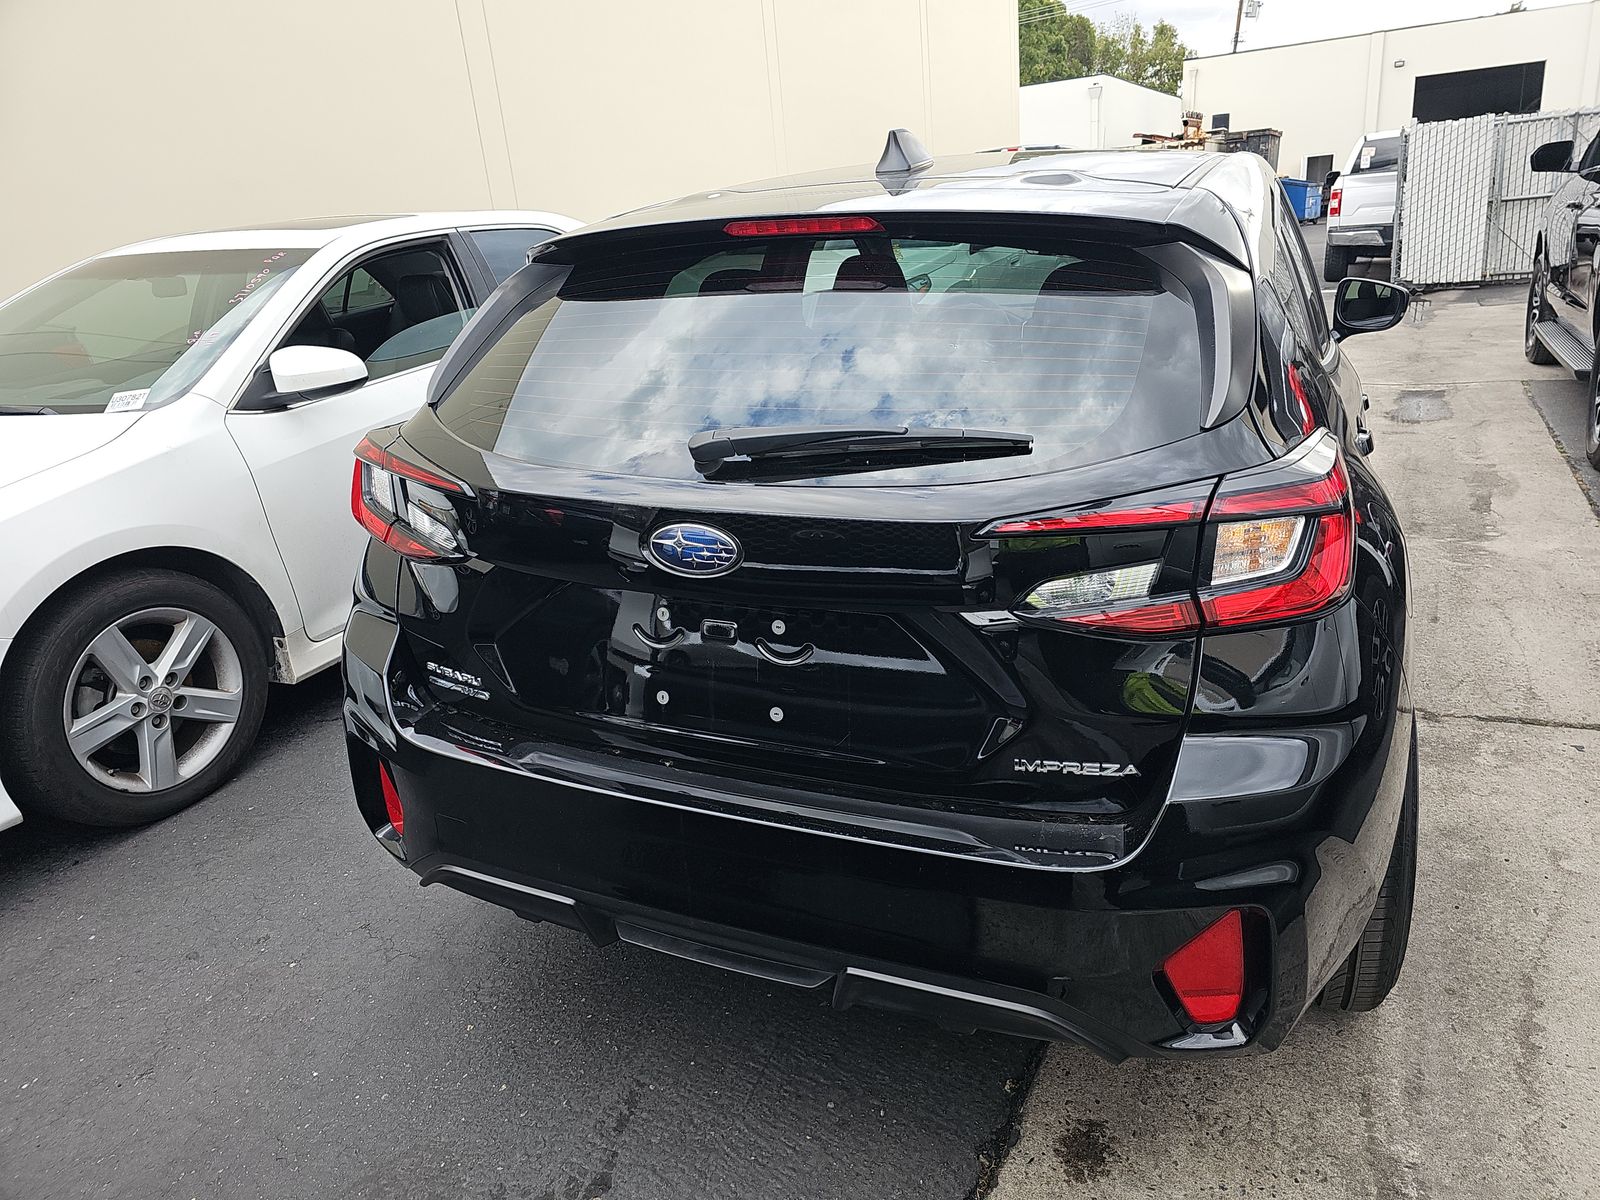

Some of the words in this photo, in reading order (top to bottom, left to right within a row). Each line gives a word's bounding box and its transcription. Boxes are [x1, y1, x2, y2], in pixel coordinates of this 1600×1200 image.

[426, 661, 482, 687] SUBARU
[450, 684, 491, 700] AWD
[1014, 758, 1142, 777] IMPREZA
